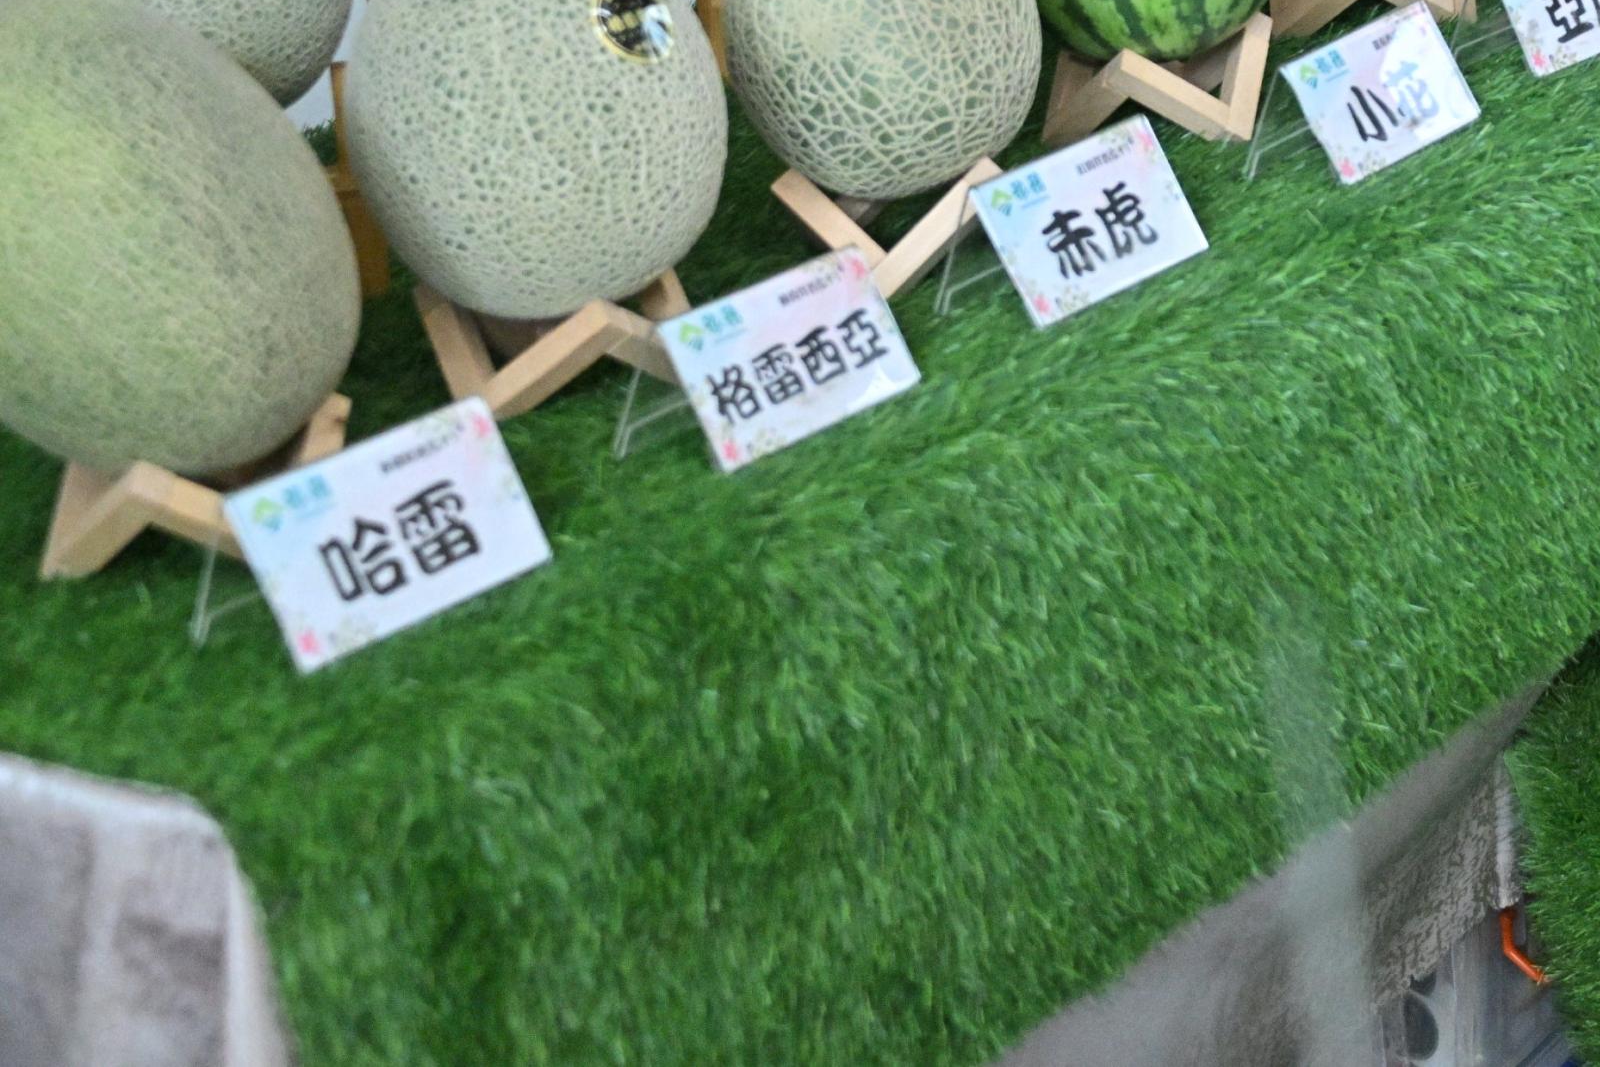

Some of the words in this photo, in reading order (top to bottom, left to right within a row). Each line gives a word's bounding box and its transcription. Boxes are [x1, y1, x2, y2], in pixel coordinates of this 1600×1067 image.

[1042, 181, 1159, 280] 赤虎
[706, 308, 890, 427] 格雷西亞
[318, 479, 482, 603] 哈雷
